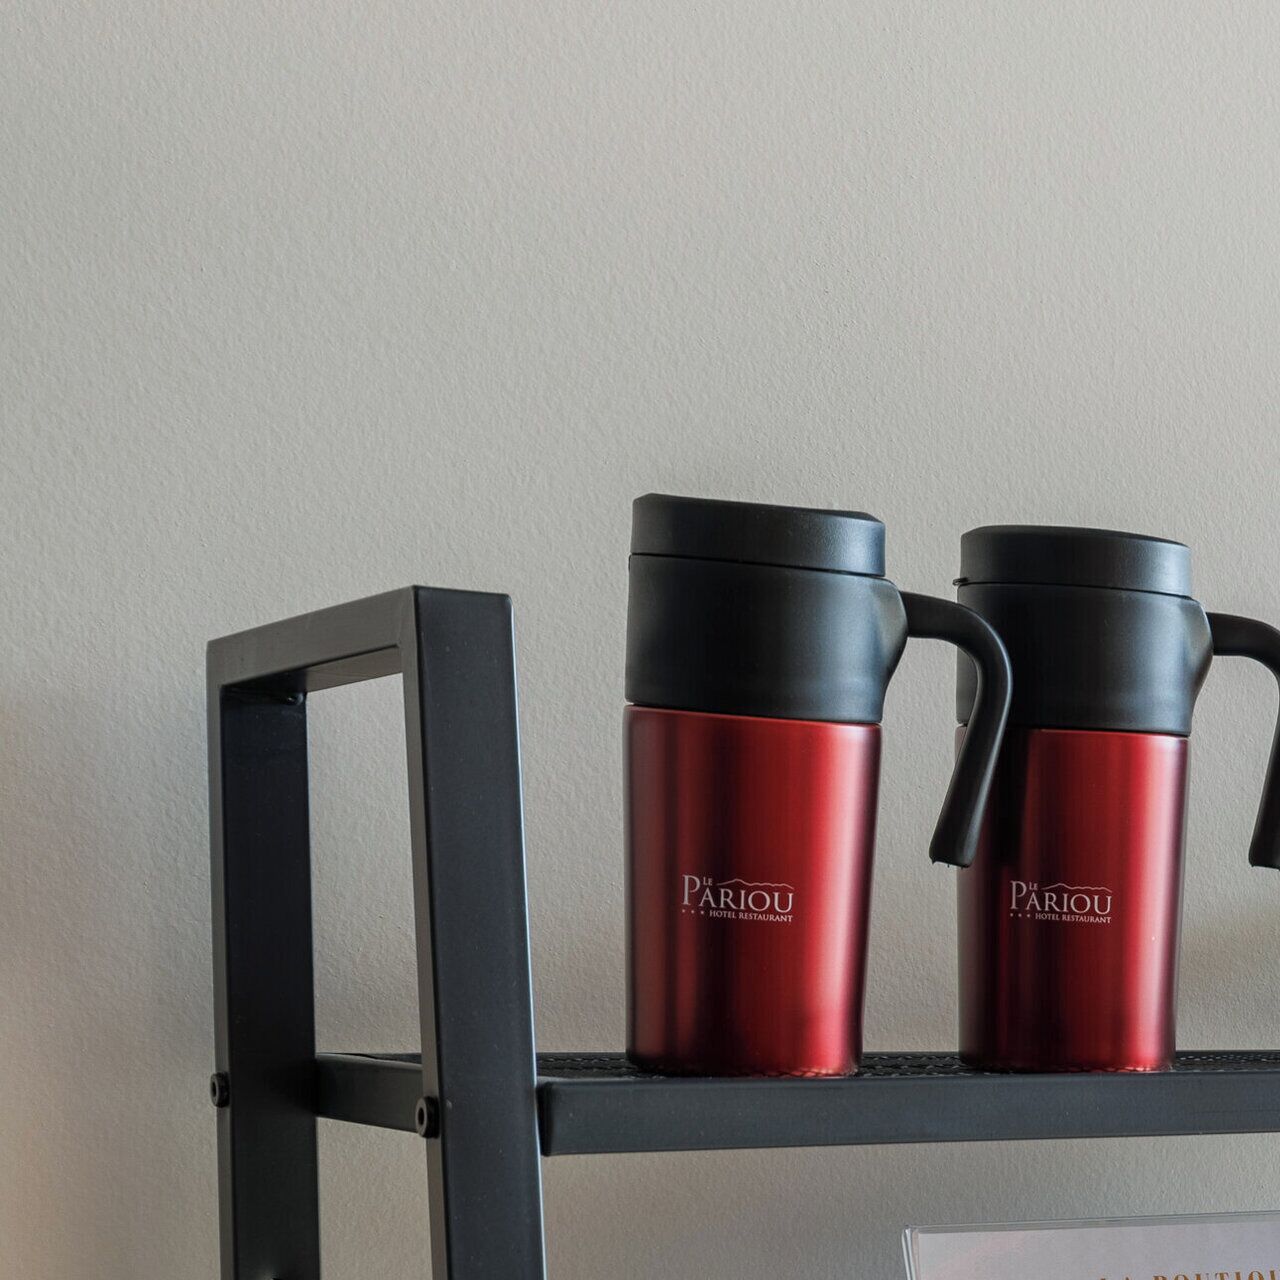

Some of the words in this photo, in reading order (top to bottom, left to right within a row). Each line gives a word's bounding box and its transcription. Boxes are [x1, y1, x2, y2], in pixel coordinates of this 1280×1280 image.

[703, 876, 713, 886] LE
[1029, 881, 1039, 891] LE
[681, 874, 795, 913] PARIOU
[1010, 880, 1113, 915] PARIOU
[709, 909, 736, 919] HOTEL
[739, 912, 793, 923] RESTAURANT
[1035, 912, 1060, 920] HOTEL
[1061, 914, 1112, 924] RESTAURANT
